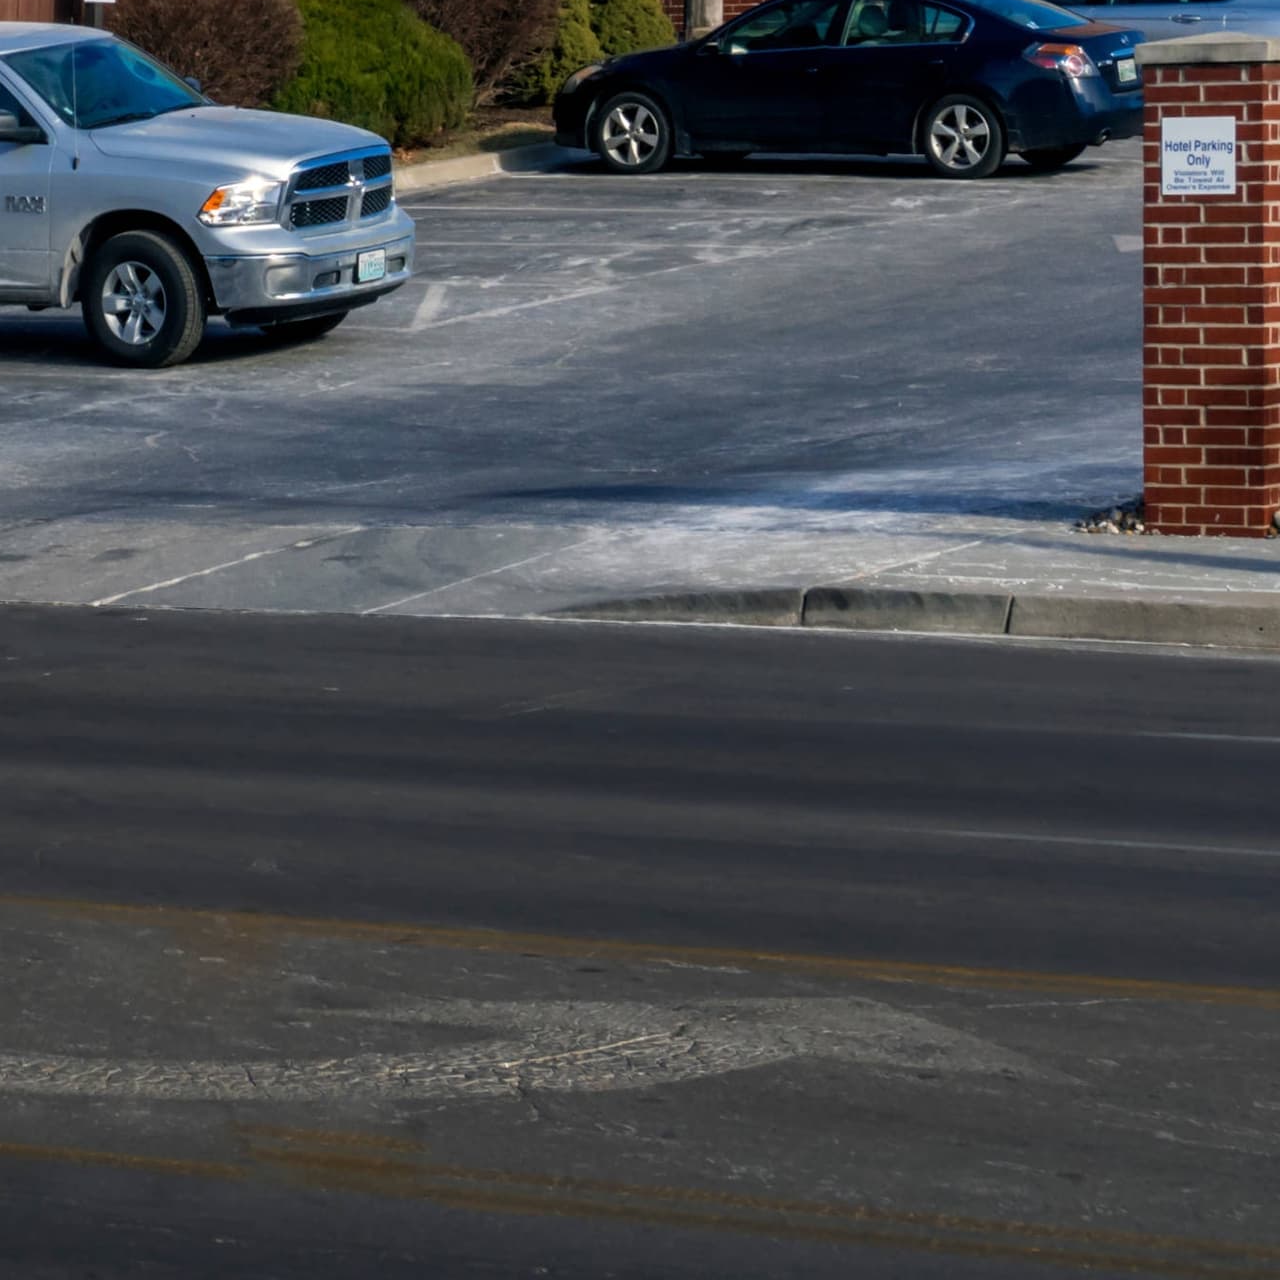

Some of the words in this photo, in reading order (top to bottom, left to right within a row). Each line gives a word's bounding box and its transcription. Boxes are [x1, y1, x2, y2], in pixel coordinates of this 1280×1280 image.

[1164, 140, 1191, 152] Hotel
[1194, 140, 1233, 154] Parking
[1186, 154, 1211, 168] Only
